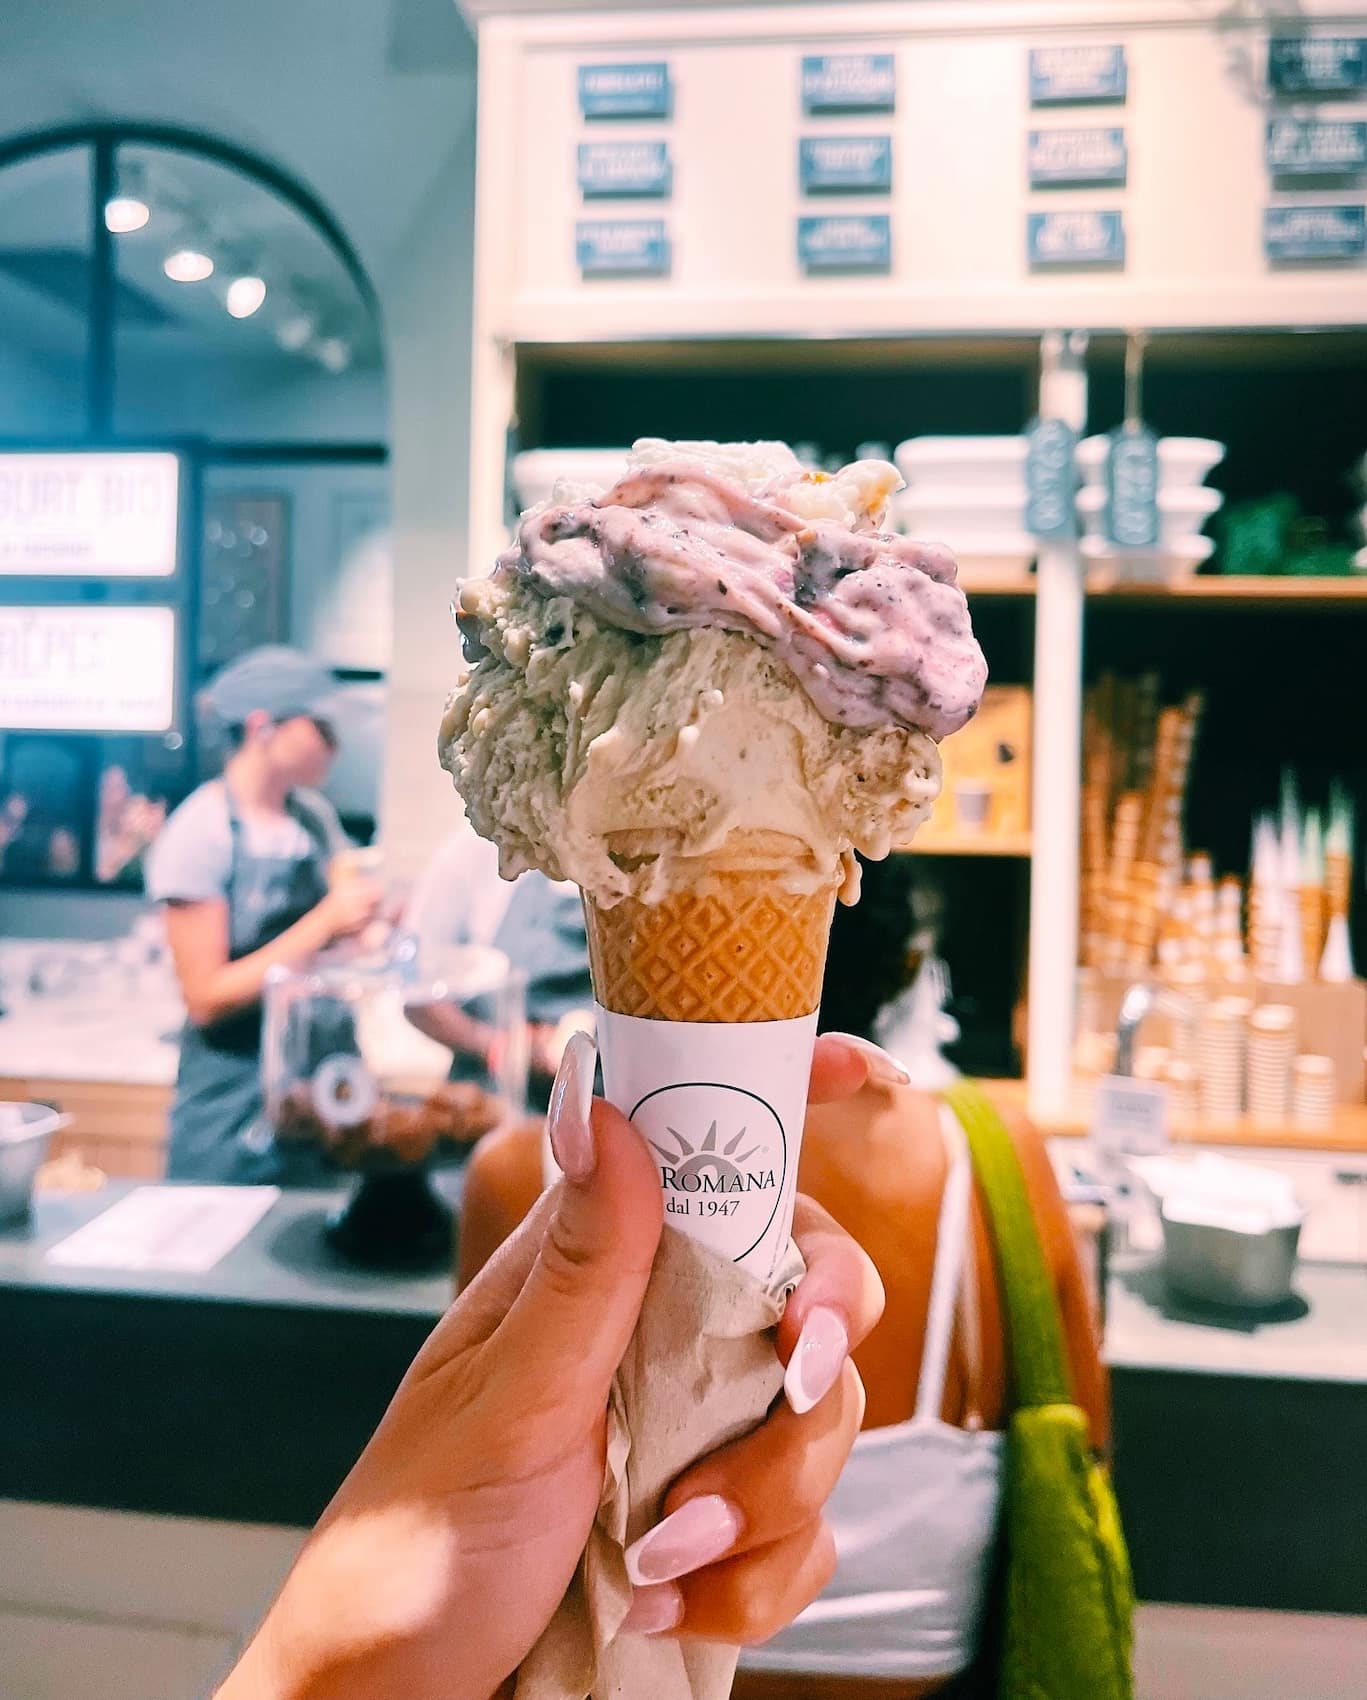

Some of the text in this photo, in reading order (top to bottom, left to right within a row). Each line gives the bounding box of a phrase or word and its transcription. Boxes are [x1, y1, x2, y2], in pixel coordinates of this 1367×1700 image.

[660, 1166, 775, 1193] ROMANA
[666, 1197, 740, 1217] dal 1947
